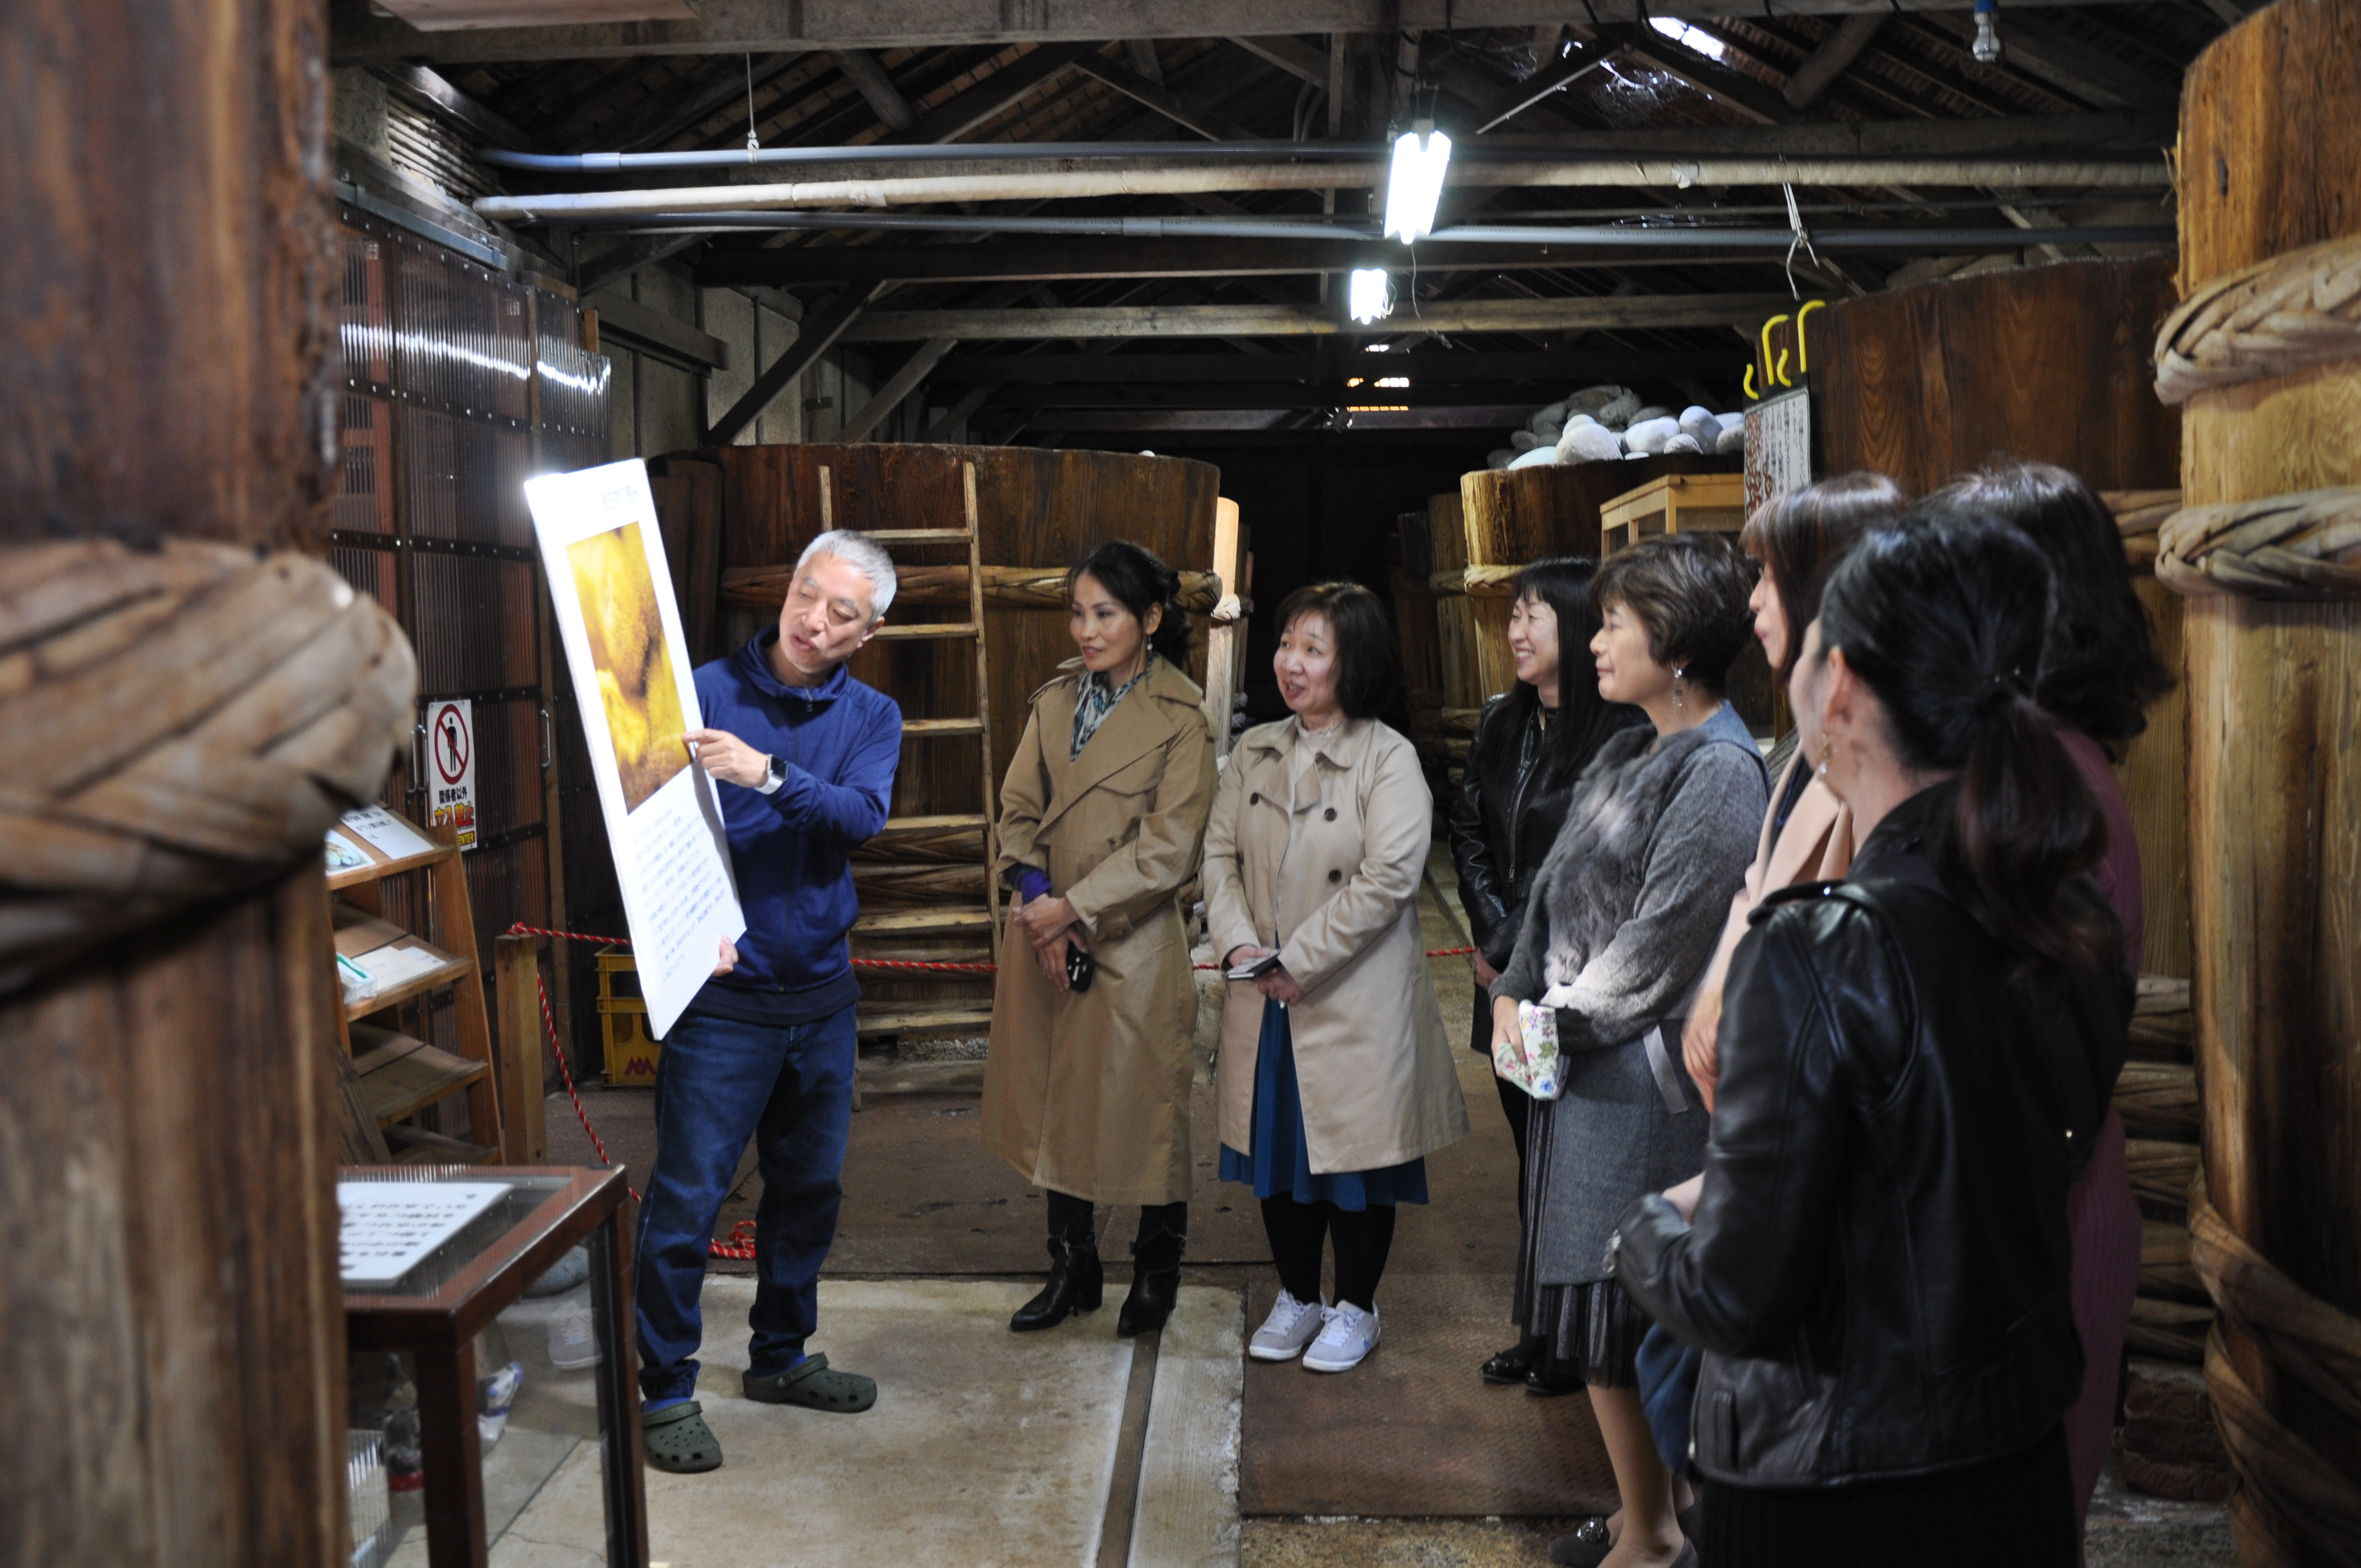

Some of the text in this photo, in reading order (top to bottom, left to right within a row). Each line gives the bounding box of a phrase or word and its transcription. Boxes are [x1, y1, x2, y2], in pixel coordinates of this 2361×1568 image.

[439, 786, 467, 804] 関係者以外
[434, 801, 474, 830] 立入禁止
